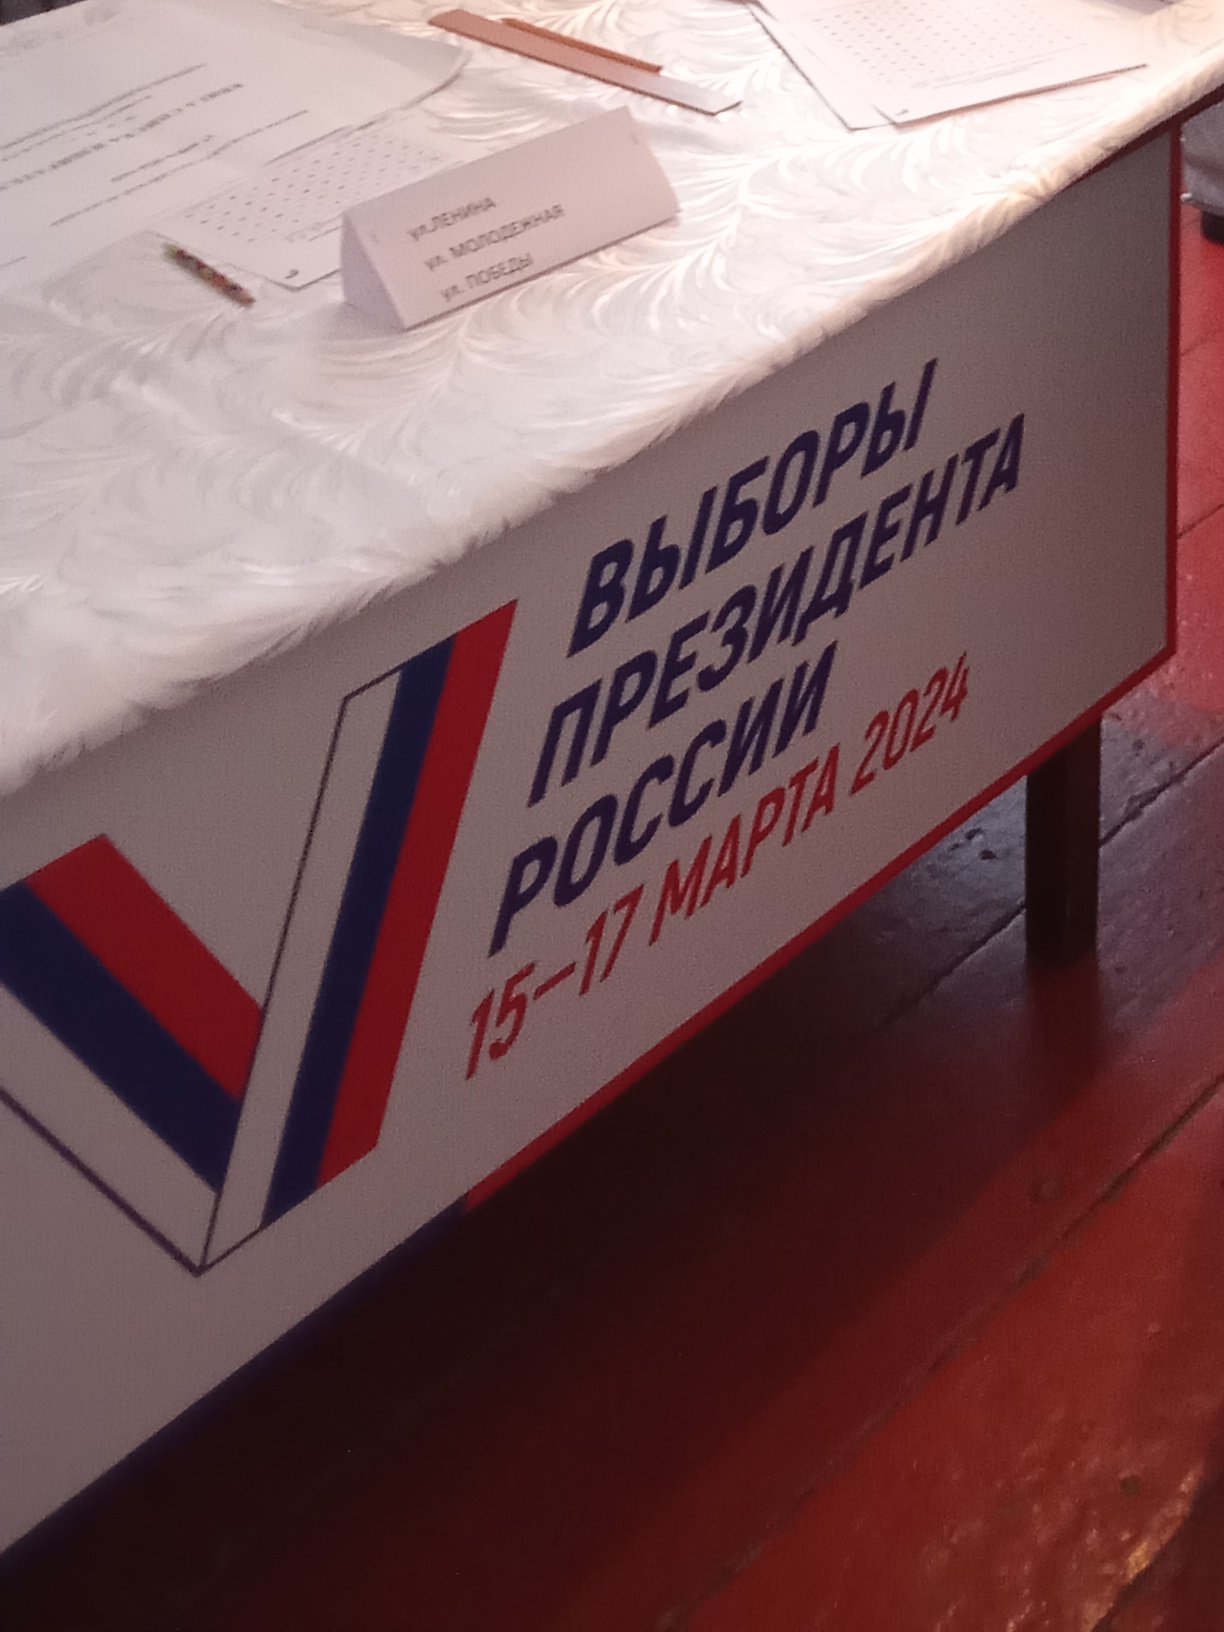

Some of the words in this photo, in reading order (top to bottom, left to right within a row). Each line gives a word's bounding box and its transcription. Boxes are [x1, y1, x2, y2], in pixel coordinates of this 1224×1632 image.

[466, 253, 533, 289] ПОБЕДЫ
[527, 414, 1025, 809] ПРЕЗИДЕНТА
[569, 358, 938, 658] ВЫБОРЫ
[489, 642, 838, 957] РОССИИ
[650, 745, 836, 947] МАРТА
[849, 652, 970, 797] 2024
